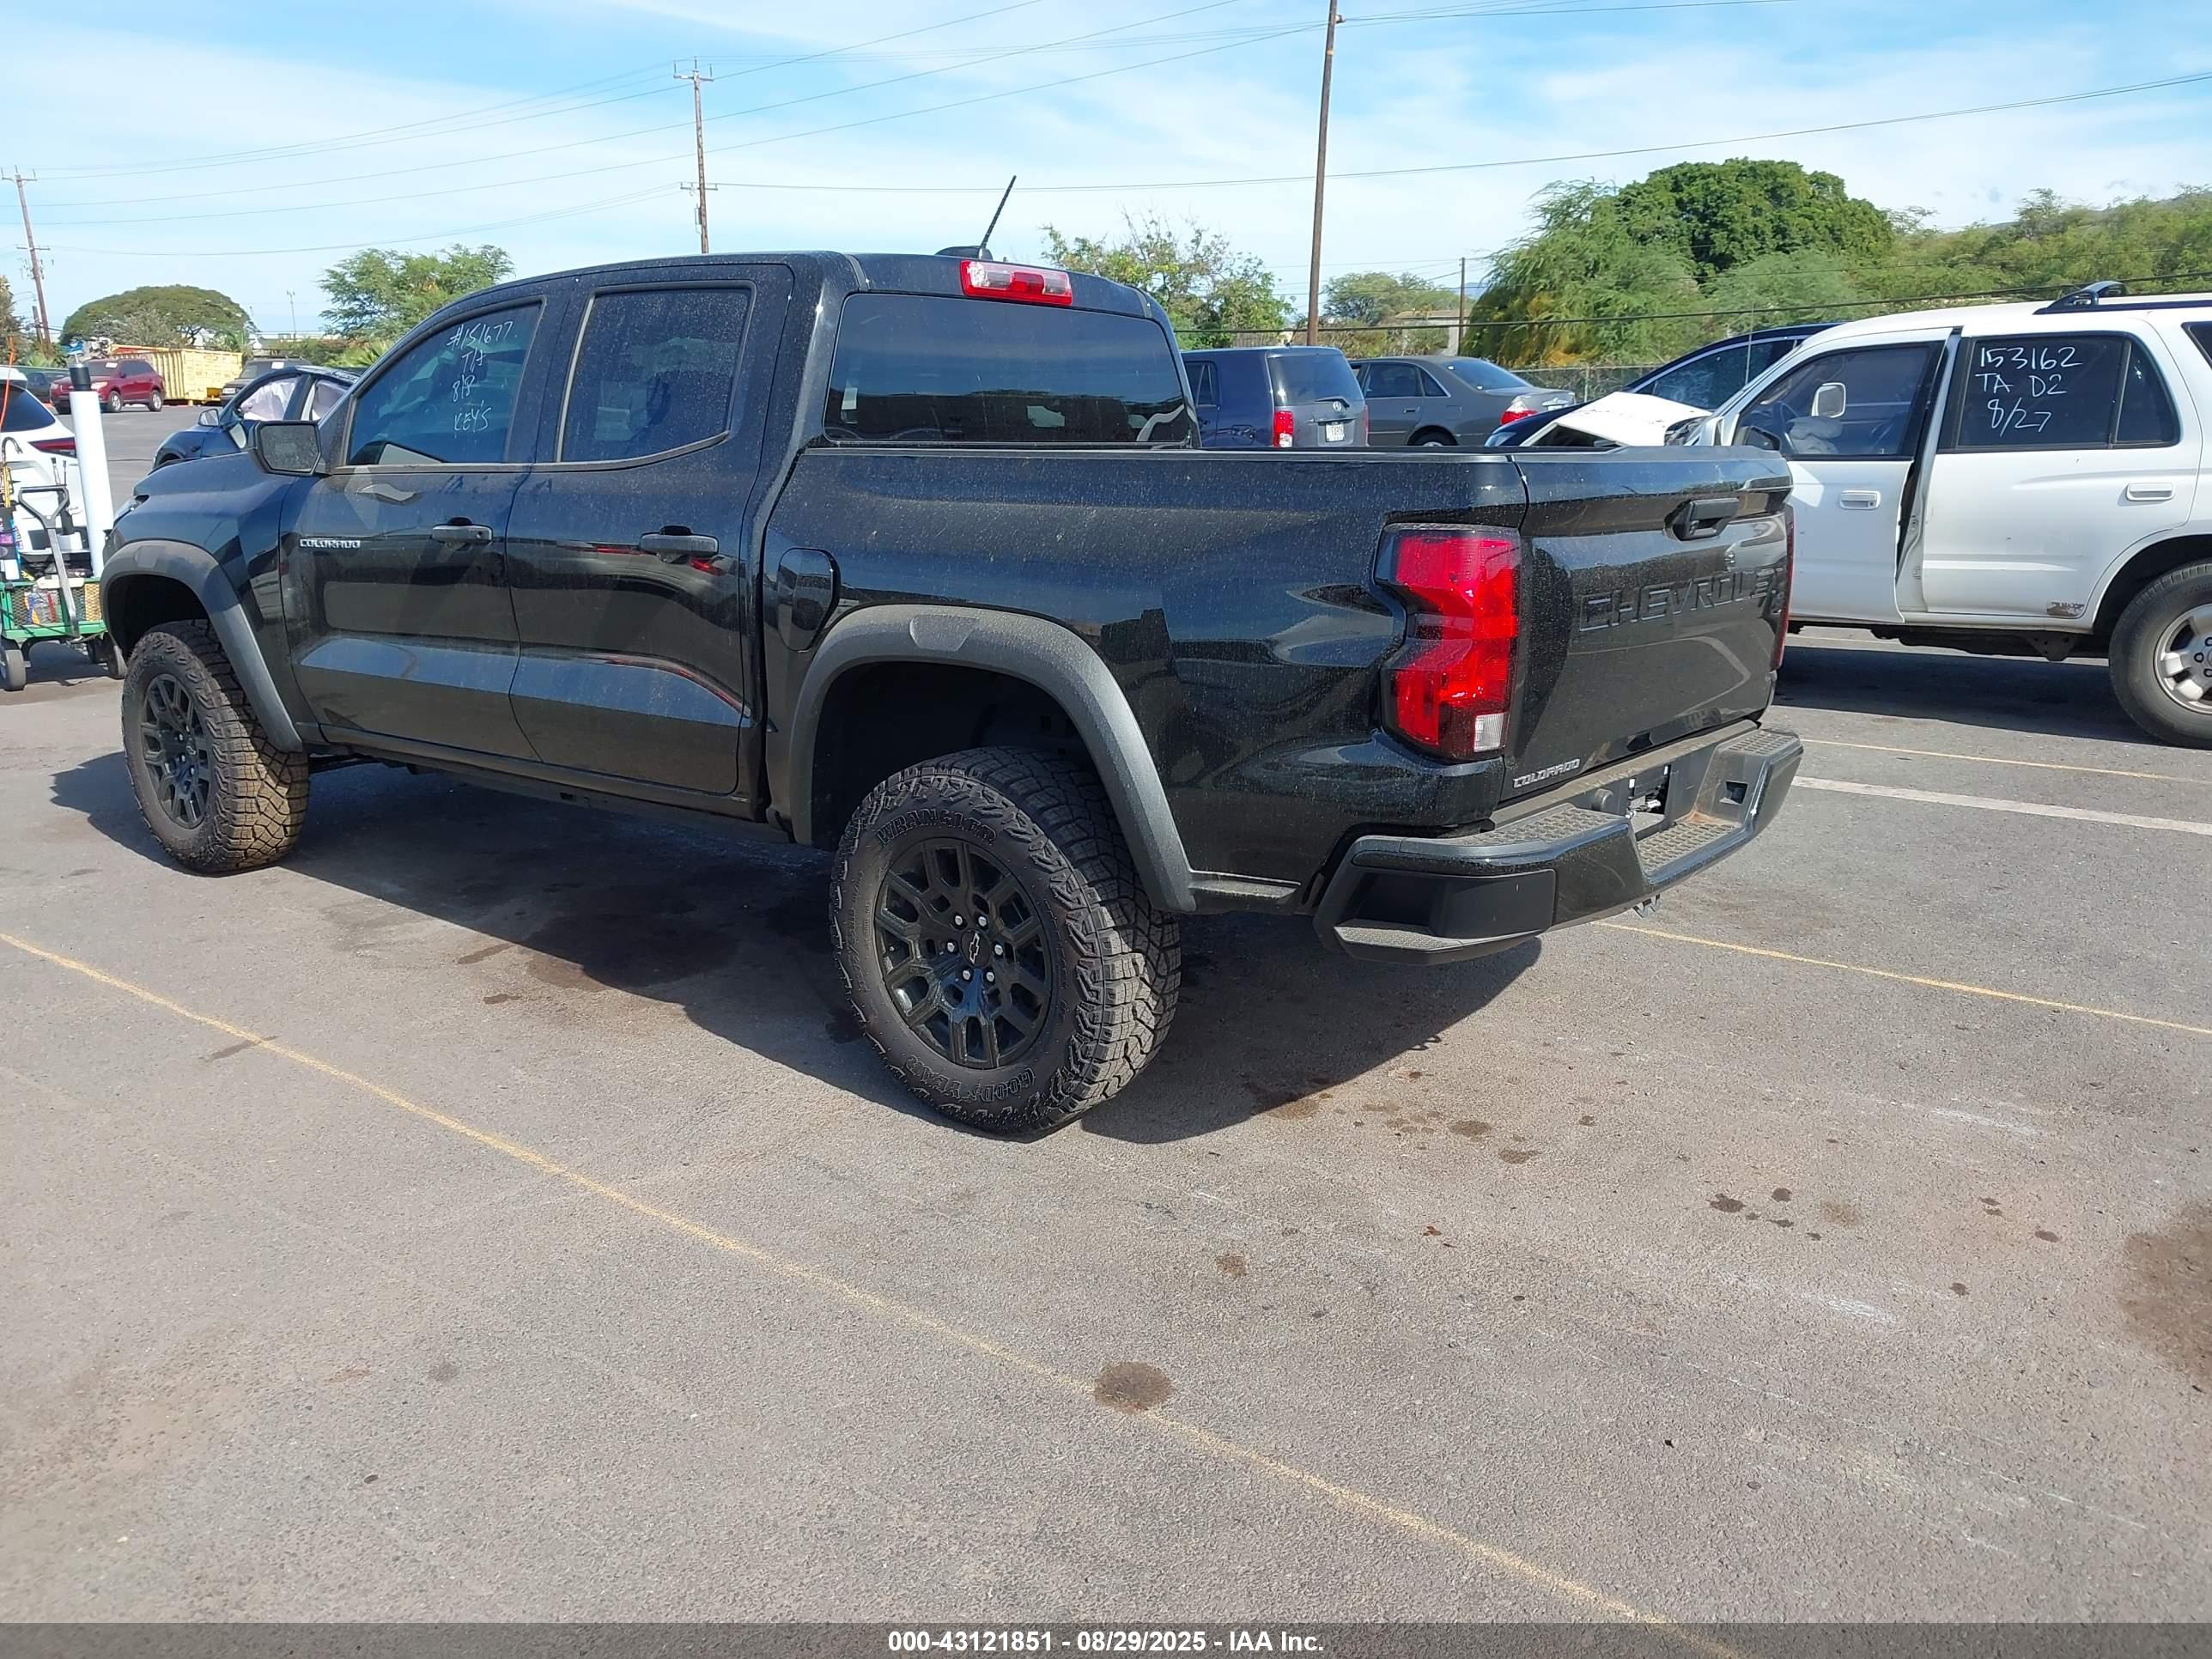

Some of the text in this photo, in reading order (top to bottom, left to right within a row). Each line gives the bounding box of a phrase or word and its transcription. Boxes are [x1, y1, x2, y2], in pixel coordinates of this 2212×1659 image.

[447, 320, 514, 350] #151677
[1979, 346, 2084, 370] 153162
[1975, 373, 2068, 398] TA D2
[1987, 397, 2052, 438] 8/27
[299, 538, 362, 549] COLORADO
[1512, 758, 1581, 789] COLORADO
